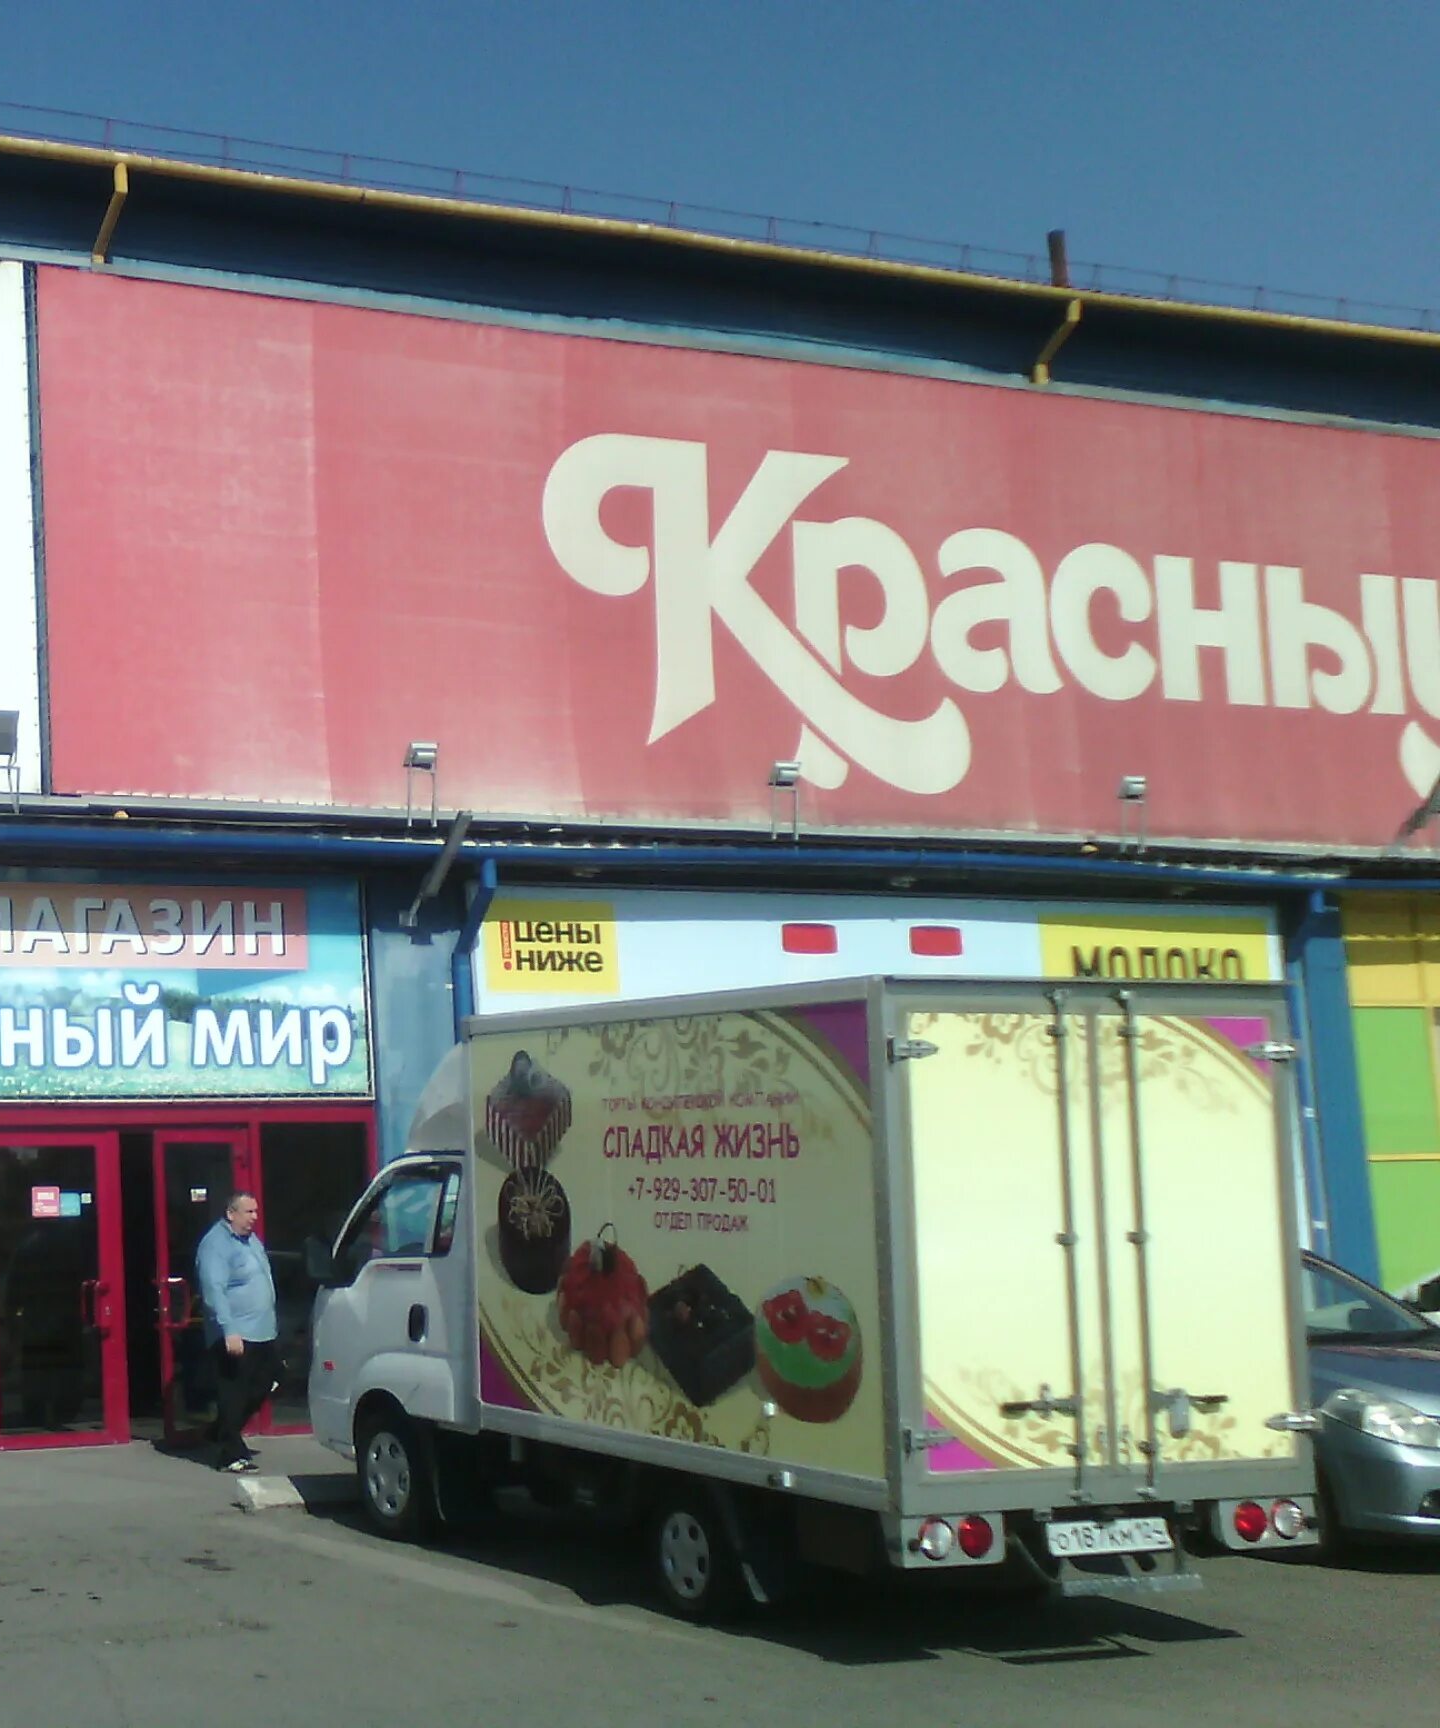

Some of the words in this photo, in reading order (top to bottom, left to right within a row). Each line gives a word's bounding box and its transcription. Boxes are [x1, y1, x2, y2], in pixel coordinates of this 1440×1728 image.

[514, 948, 605, 973] ниже
[191, 1006, 354, 1085] мир
[602, 1123, 706, 1164] СЛАДКАЯ
[712, 1122, 801, 1159] ЖИЗНЬ
[627, 1176, 777, 1204] +7-929-307-50-01
[653, 1210, 693, 1231] ОТДЕЛ
[696, 1211, 750, 1233] ПРОДАЖ
